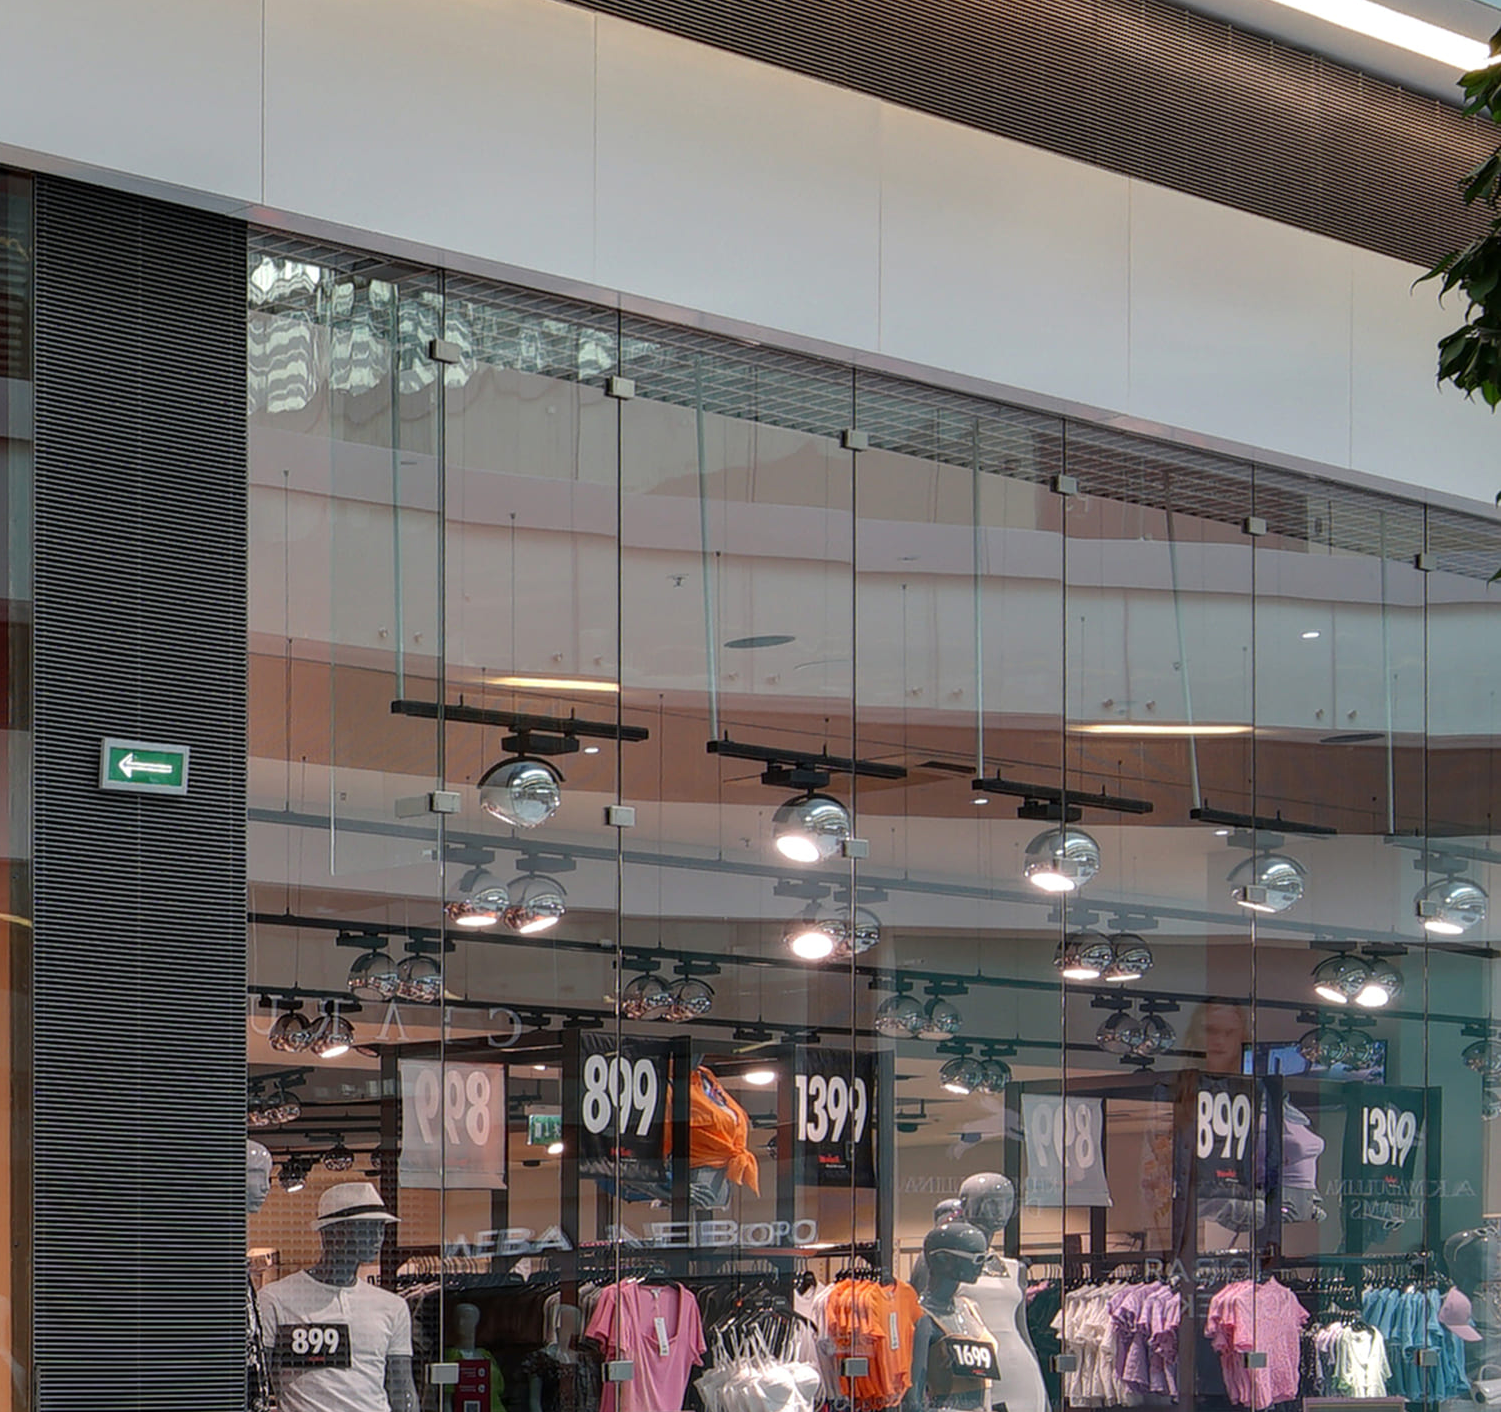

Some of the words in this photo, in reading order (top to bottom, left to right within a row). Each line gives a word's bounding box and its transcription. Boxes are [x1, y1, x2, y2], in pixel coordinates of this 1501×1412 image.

[583, 1053, 658, 1136] 899
[796, 1074, 867, 1143] 1399
[1197, 1092, 1250, 1160] 899
[1363, 1107, 1416, 1168] 1399
[290, 1327, 339, 1355] 899
[953, 1345, 992, 1371] 1699
